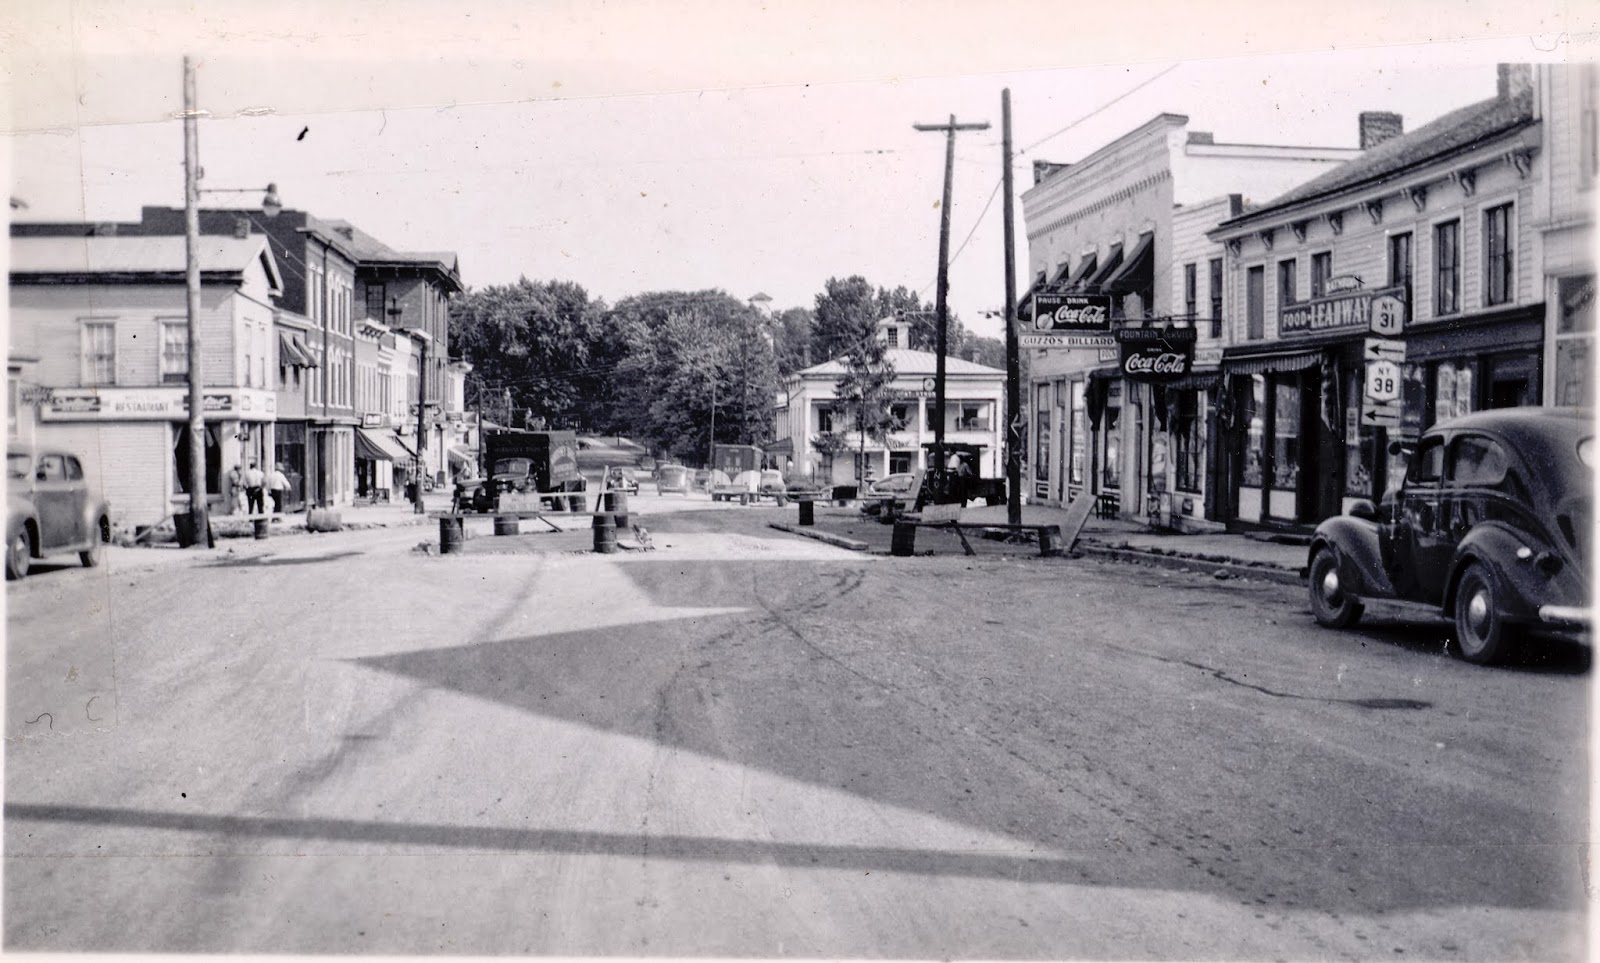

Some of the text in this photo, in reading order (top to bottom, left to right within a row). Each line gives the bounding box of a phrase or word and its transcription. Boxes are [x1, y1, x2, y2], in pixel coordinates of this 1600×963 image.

[1066, 297, 1089, 305] DRINK
[1283, 296, 1371, 329] FOOD LEADWAY
[1382, 303, 1394, 311] NY
[1380, 314, 1395, 329] 31
[1119, 329, 1158, 340] FOUNTAIN
[1067, 336, 1114, 347] BILLIARD
[1378, 368, 1391, 376] NY
[1374, 378, 1394, 394] 38
[114, 402, 170, 413] RESTAURANT
